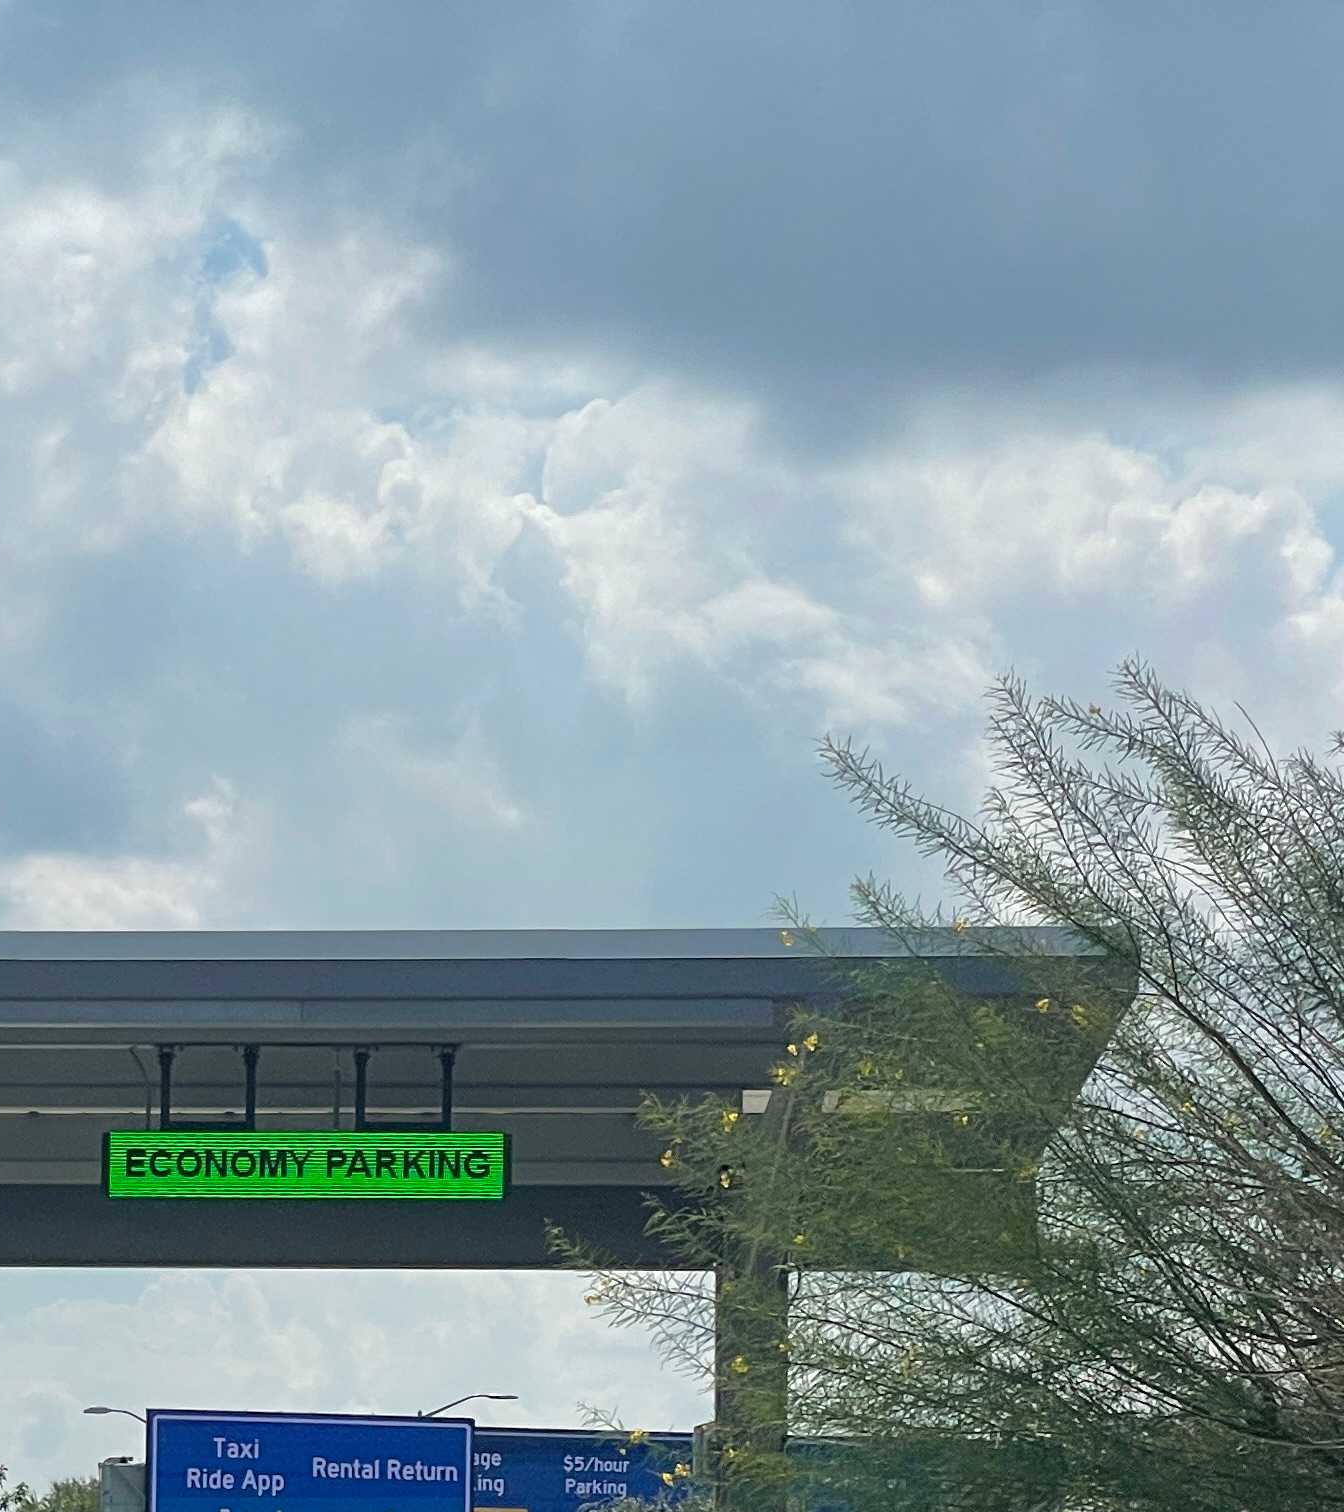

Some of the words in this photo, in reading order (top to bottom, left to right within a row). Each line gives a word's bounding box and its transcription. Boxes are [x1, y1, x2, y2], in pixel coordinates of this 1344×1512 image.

[125, 1148, 310, 1178] ECONOMY
[326, 1149, 492, 1179] PARKING
[213, 1437, 260, 1459] Taxi
[312, 1456, 380, 1479] Rental
[387, 1458, 458, 1482] Return
[563, 1454, 630, 1473] $5/hour
[186, 1467, 235, 1489] Ride
[241, 1468, 285, 1496] App
[565, 1478, 627, 1500] Parking
